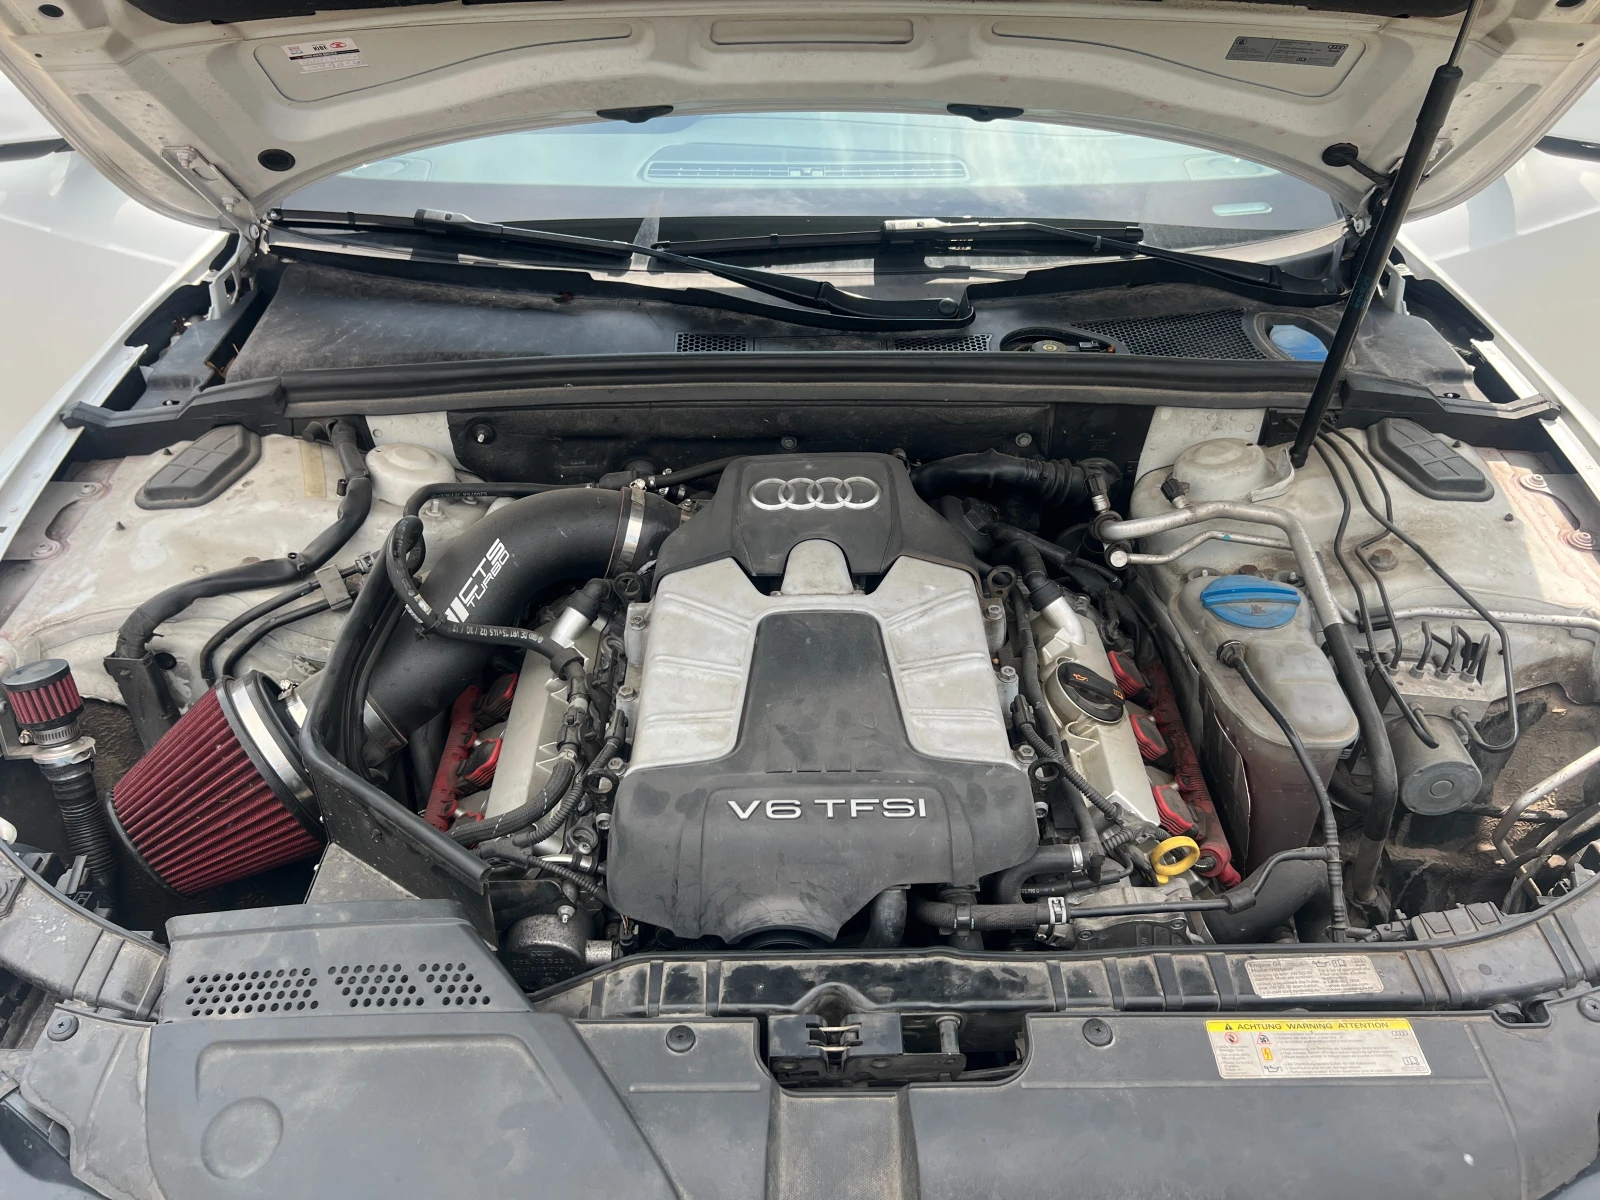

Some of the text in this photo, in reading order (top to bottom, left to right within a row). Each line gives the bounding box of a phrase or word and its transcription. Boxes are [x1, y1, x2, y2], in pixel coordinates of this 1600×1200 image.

[459, 538, 506, 604] CTS
[466, 549, 510, 608] TURBO
[727, 798, 926, 821] V6 TFSI
[1237, 1021, 1389, 1030] ACHTUNG WARNING ATTENTION
